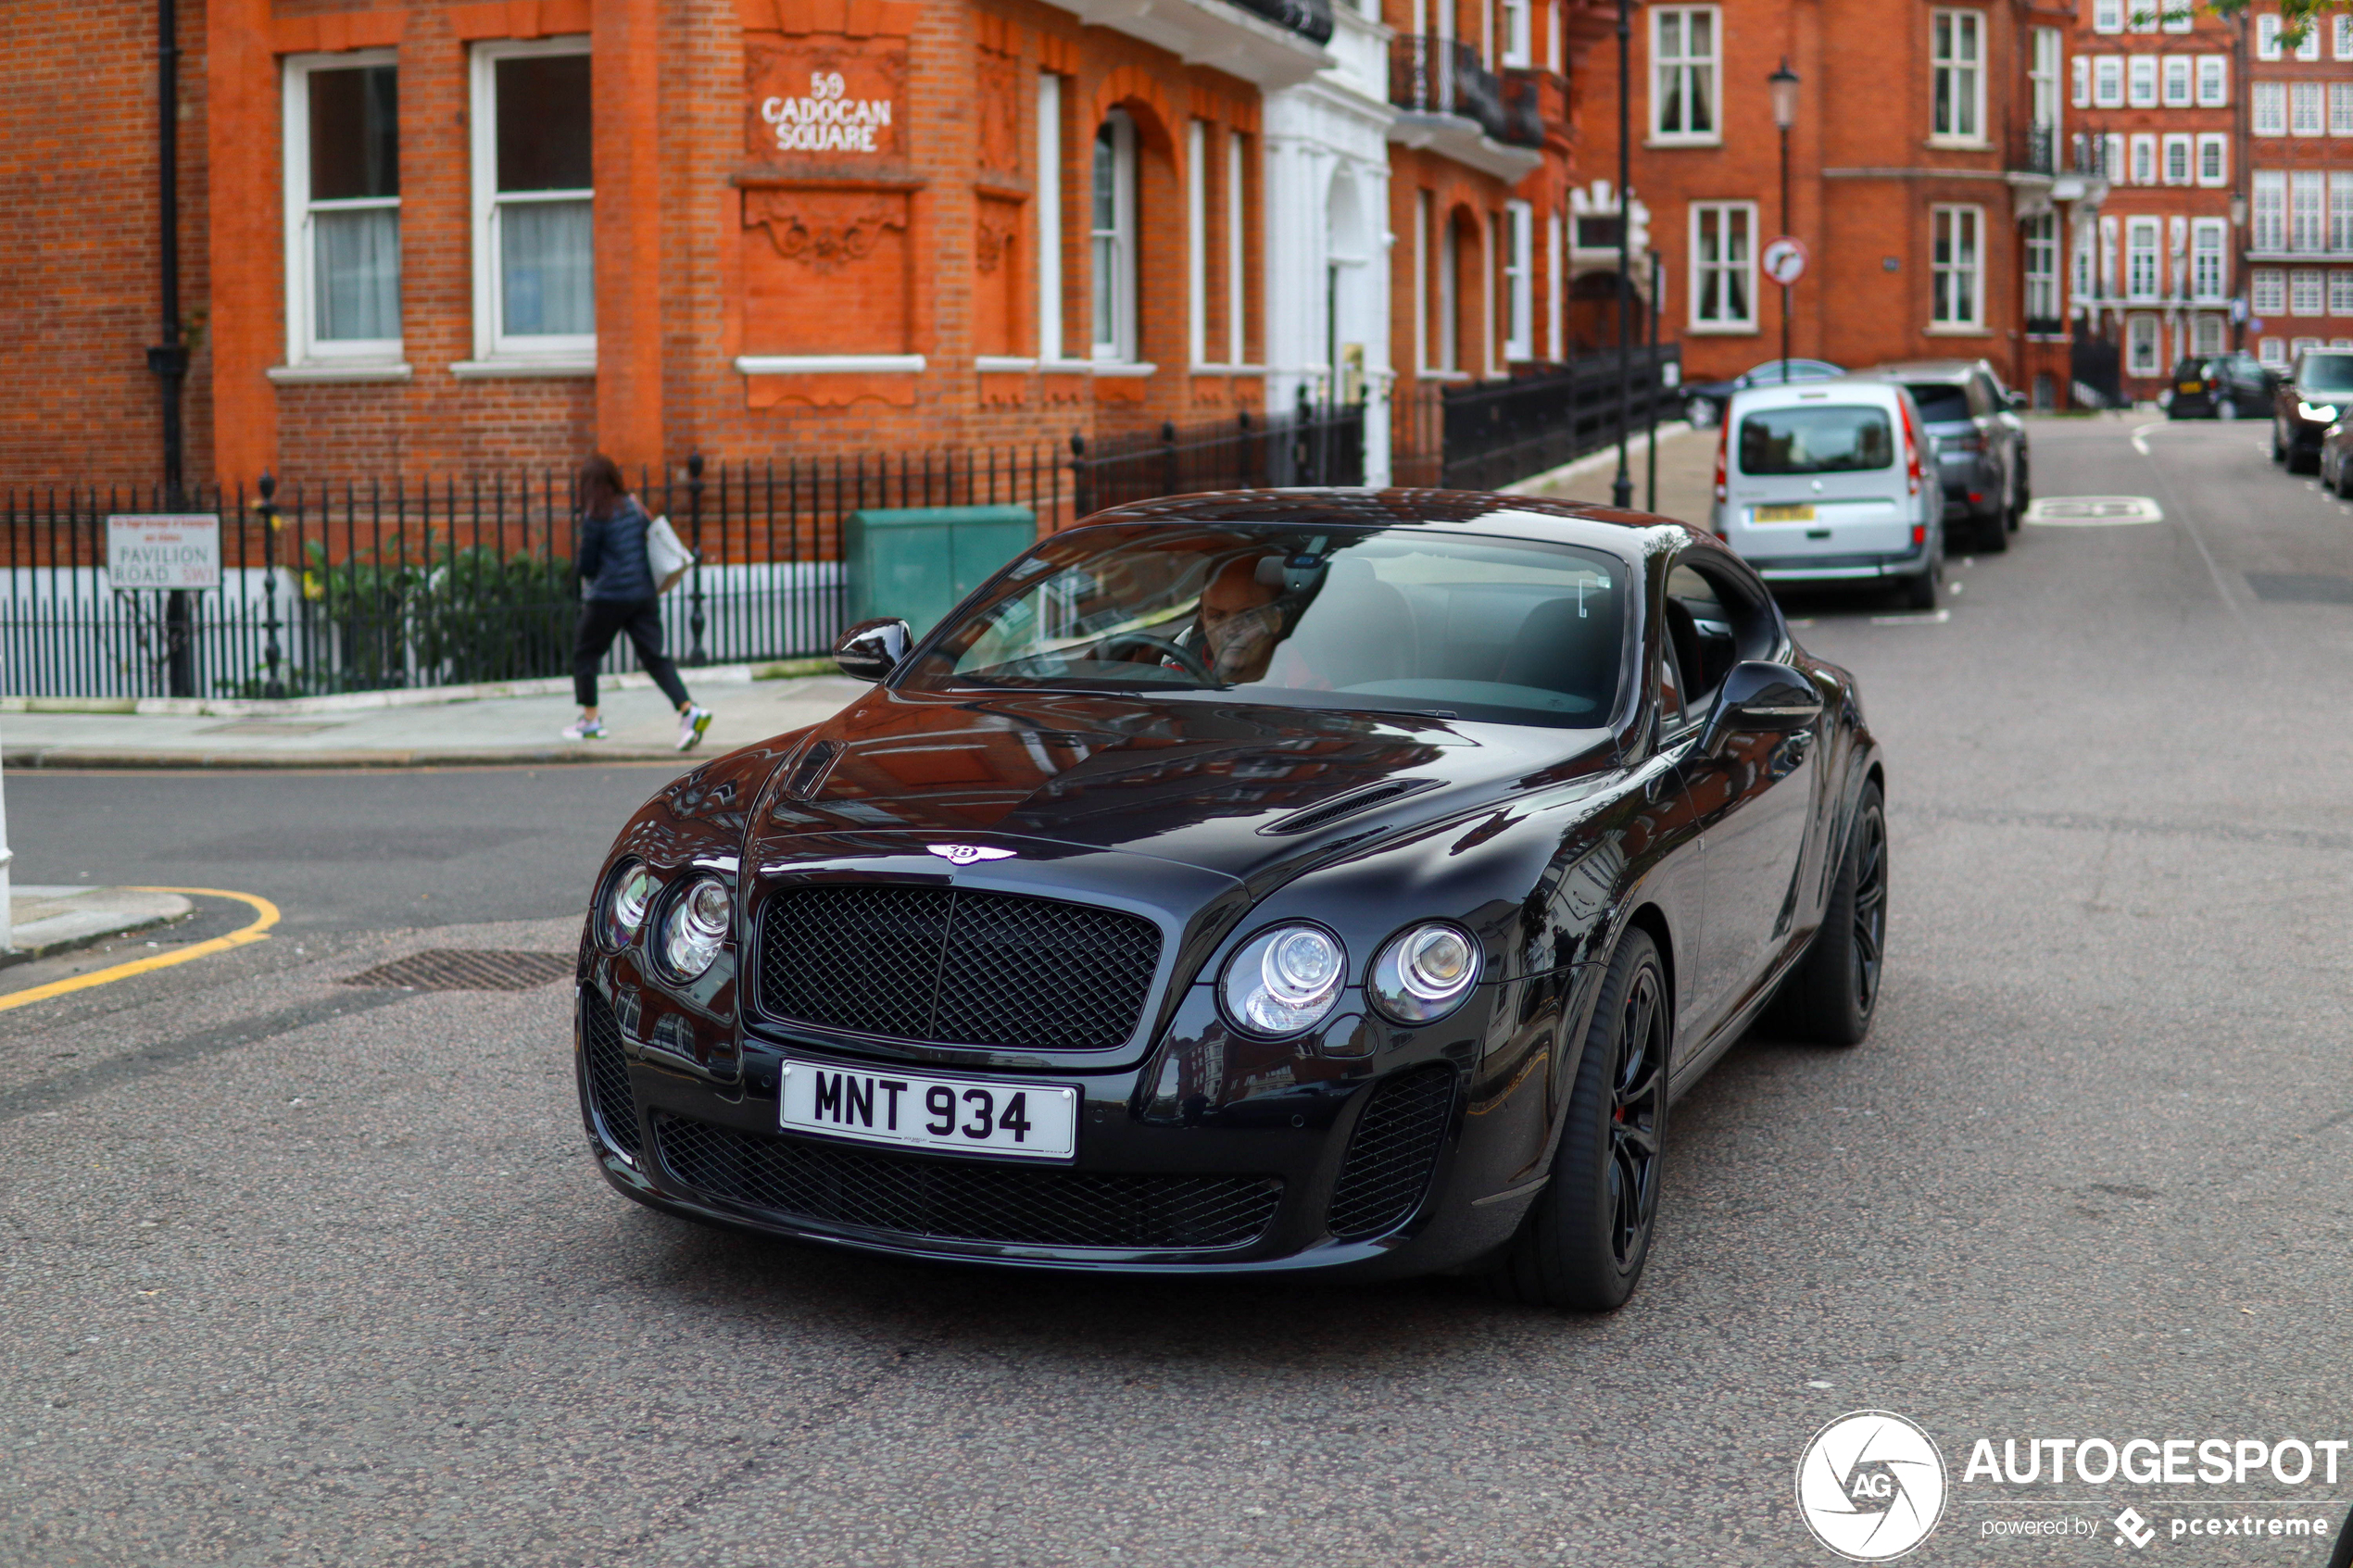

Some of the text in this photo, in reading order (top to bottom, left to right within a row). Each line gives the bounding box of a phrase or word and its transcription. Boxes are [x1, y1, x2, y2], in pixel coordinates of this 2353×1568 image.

[811, 71, 845, 100] 59
[776, 123, 877, 152] SQUARE
[120, 546, 208, 564] PAVILION
[115, 565, 170, 583] ROAD
[815, 1071, 1031, 1143] MNT 934
